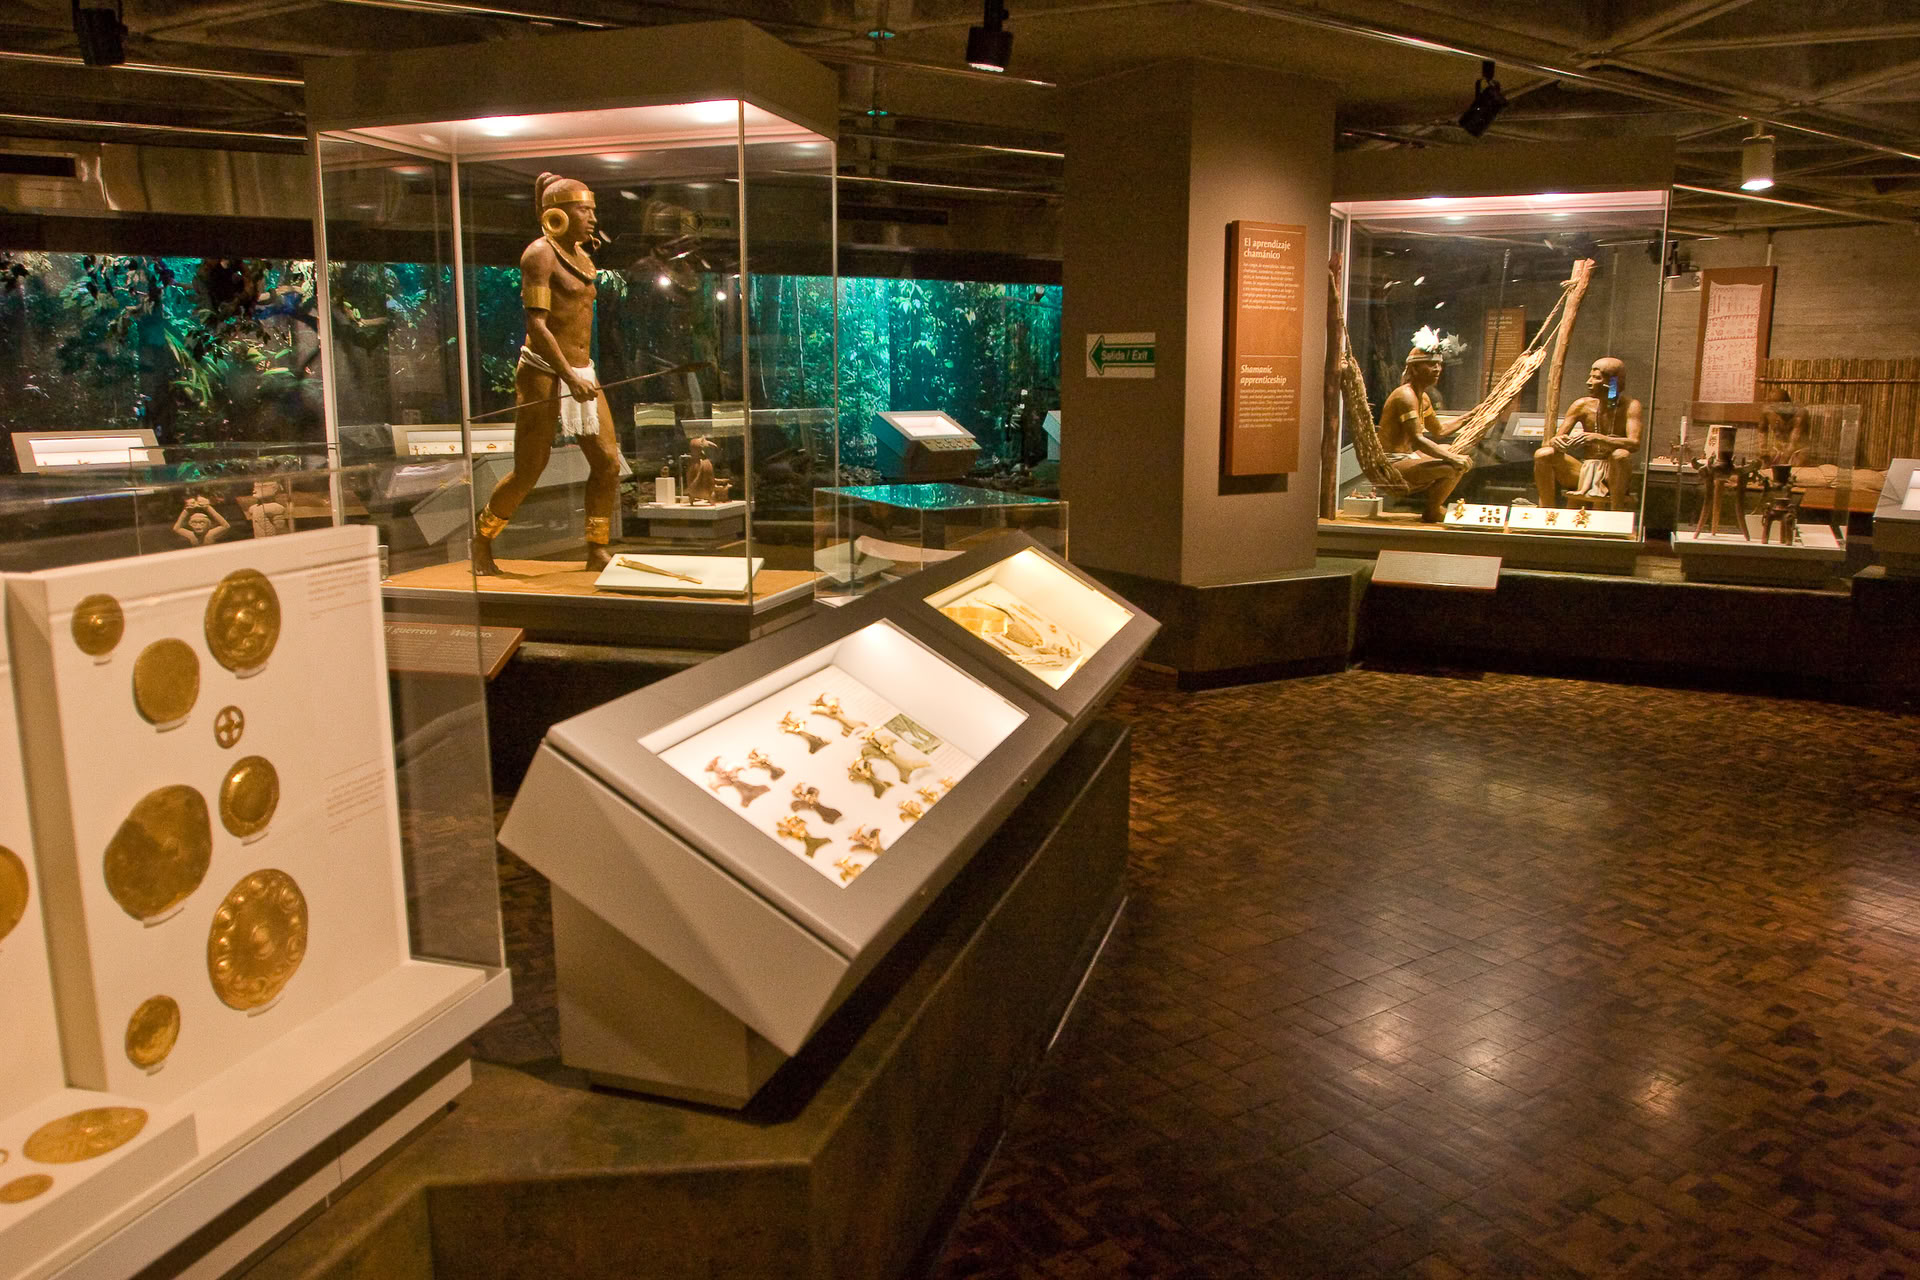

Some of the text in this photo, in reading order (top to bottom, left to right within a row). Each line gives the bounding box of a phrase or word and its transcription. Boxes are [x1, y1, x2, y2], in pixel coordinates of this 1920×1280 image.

[1244, 238, 1291, 251] El aprendizaje
[1244, 248, 1281, 259] chamánico
[1101, 350, 1124, 360] Salida
[1132, 350, 1148, 360] Exit
[1241, 364, 1272, 374] Shamanic
[1240, 375, 1287, 386] apprenticeship
[392, 626, 437, 635] guerrero
